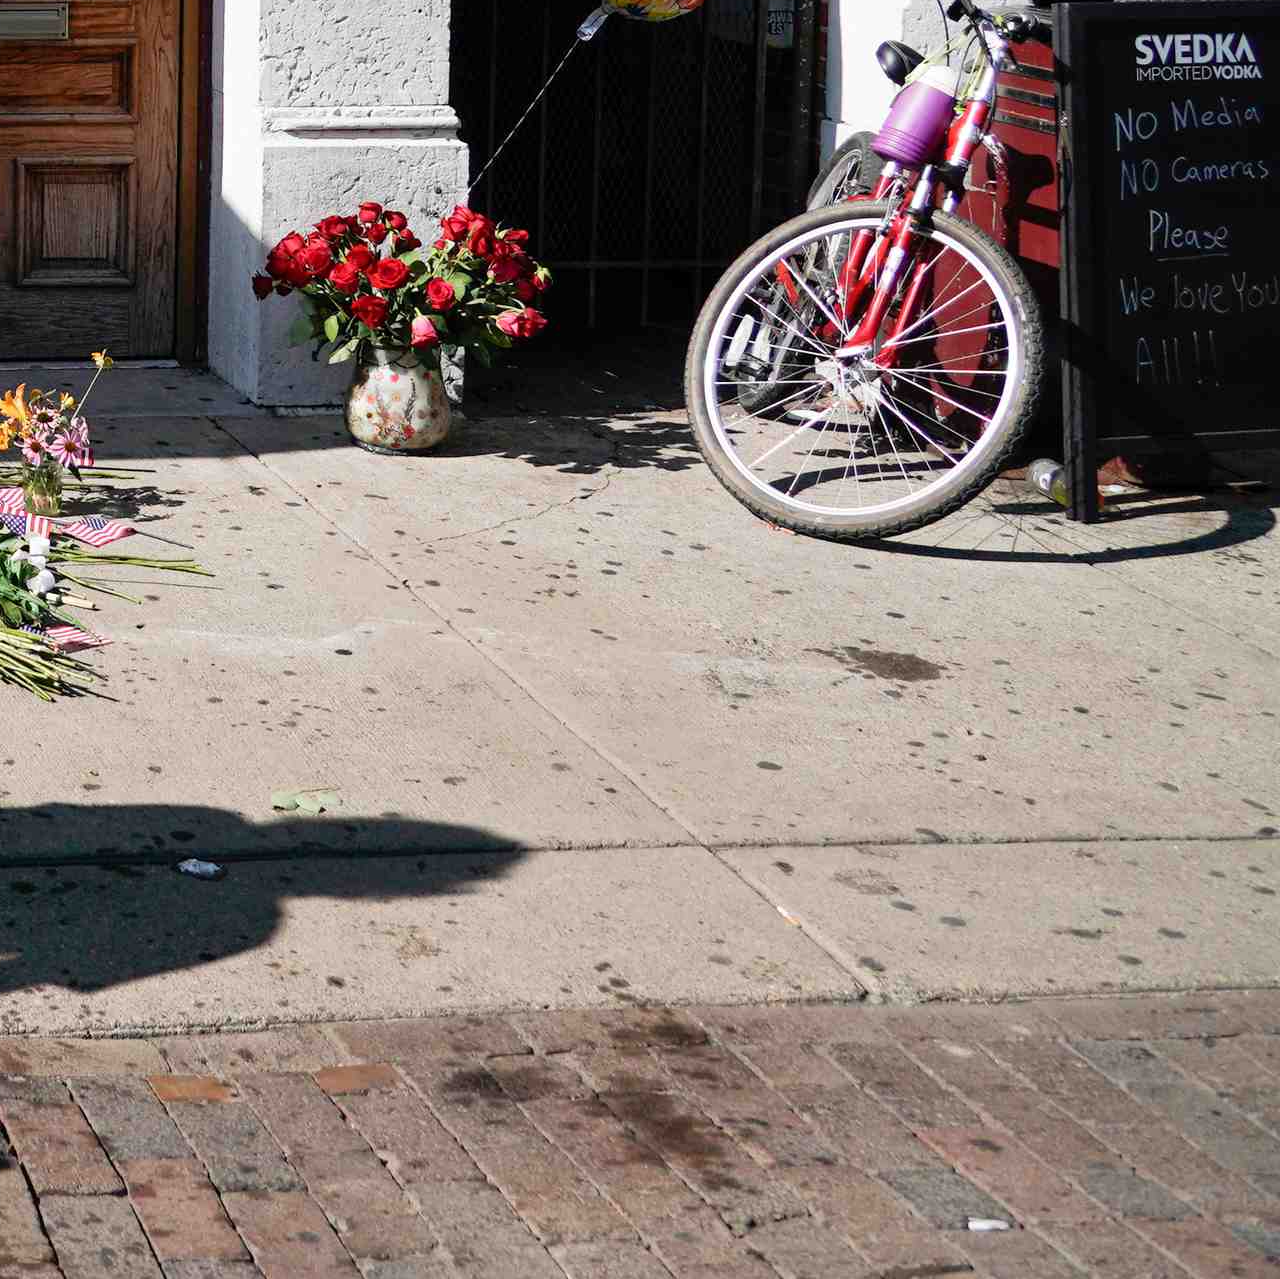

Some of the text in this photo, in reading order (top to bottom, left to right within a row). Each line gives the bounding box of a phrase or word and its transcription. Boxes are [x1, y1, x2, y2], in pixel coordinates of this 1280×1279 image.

[1135, 31, 1256, 65] SVEDKA
[1114, 96, 1262, 152] NO Media
[1120, 155, 1270, 201] NO Cameras
[1148, 208, 1230, 254] Please
[1120, 275, 1155, 315] We
[1173, 272, 1232, 313] love
